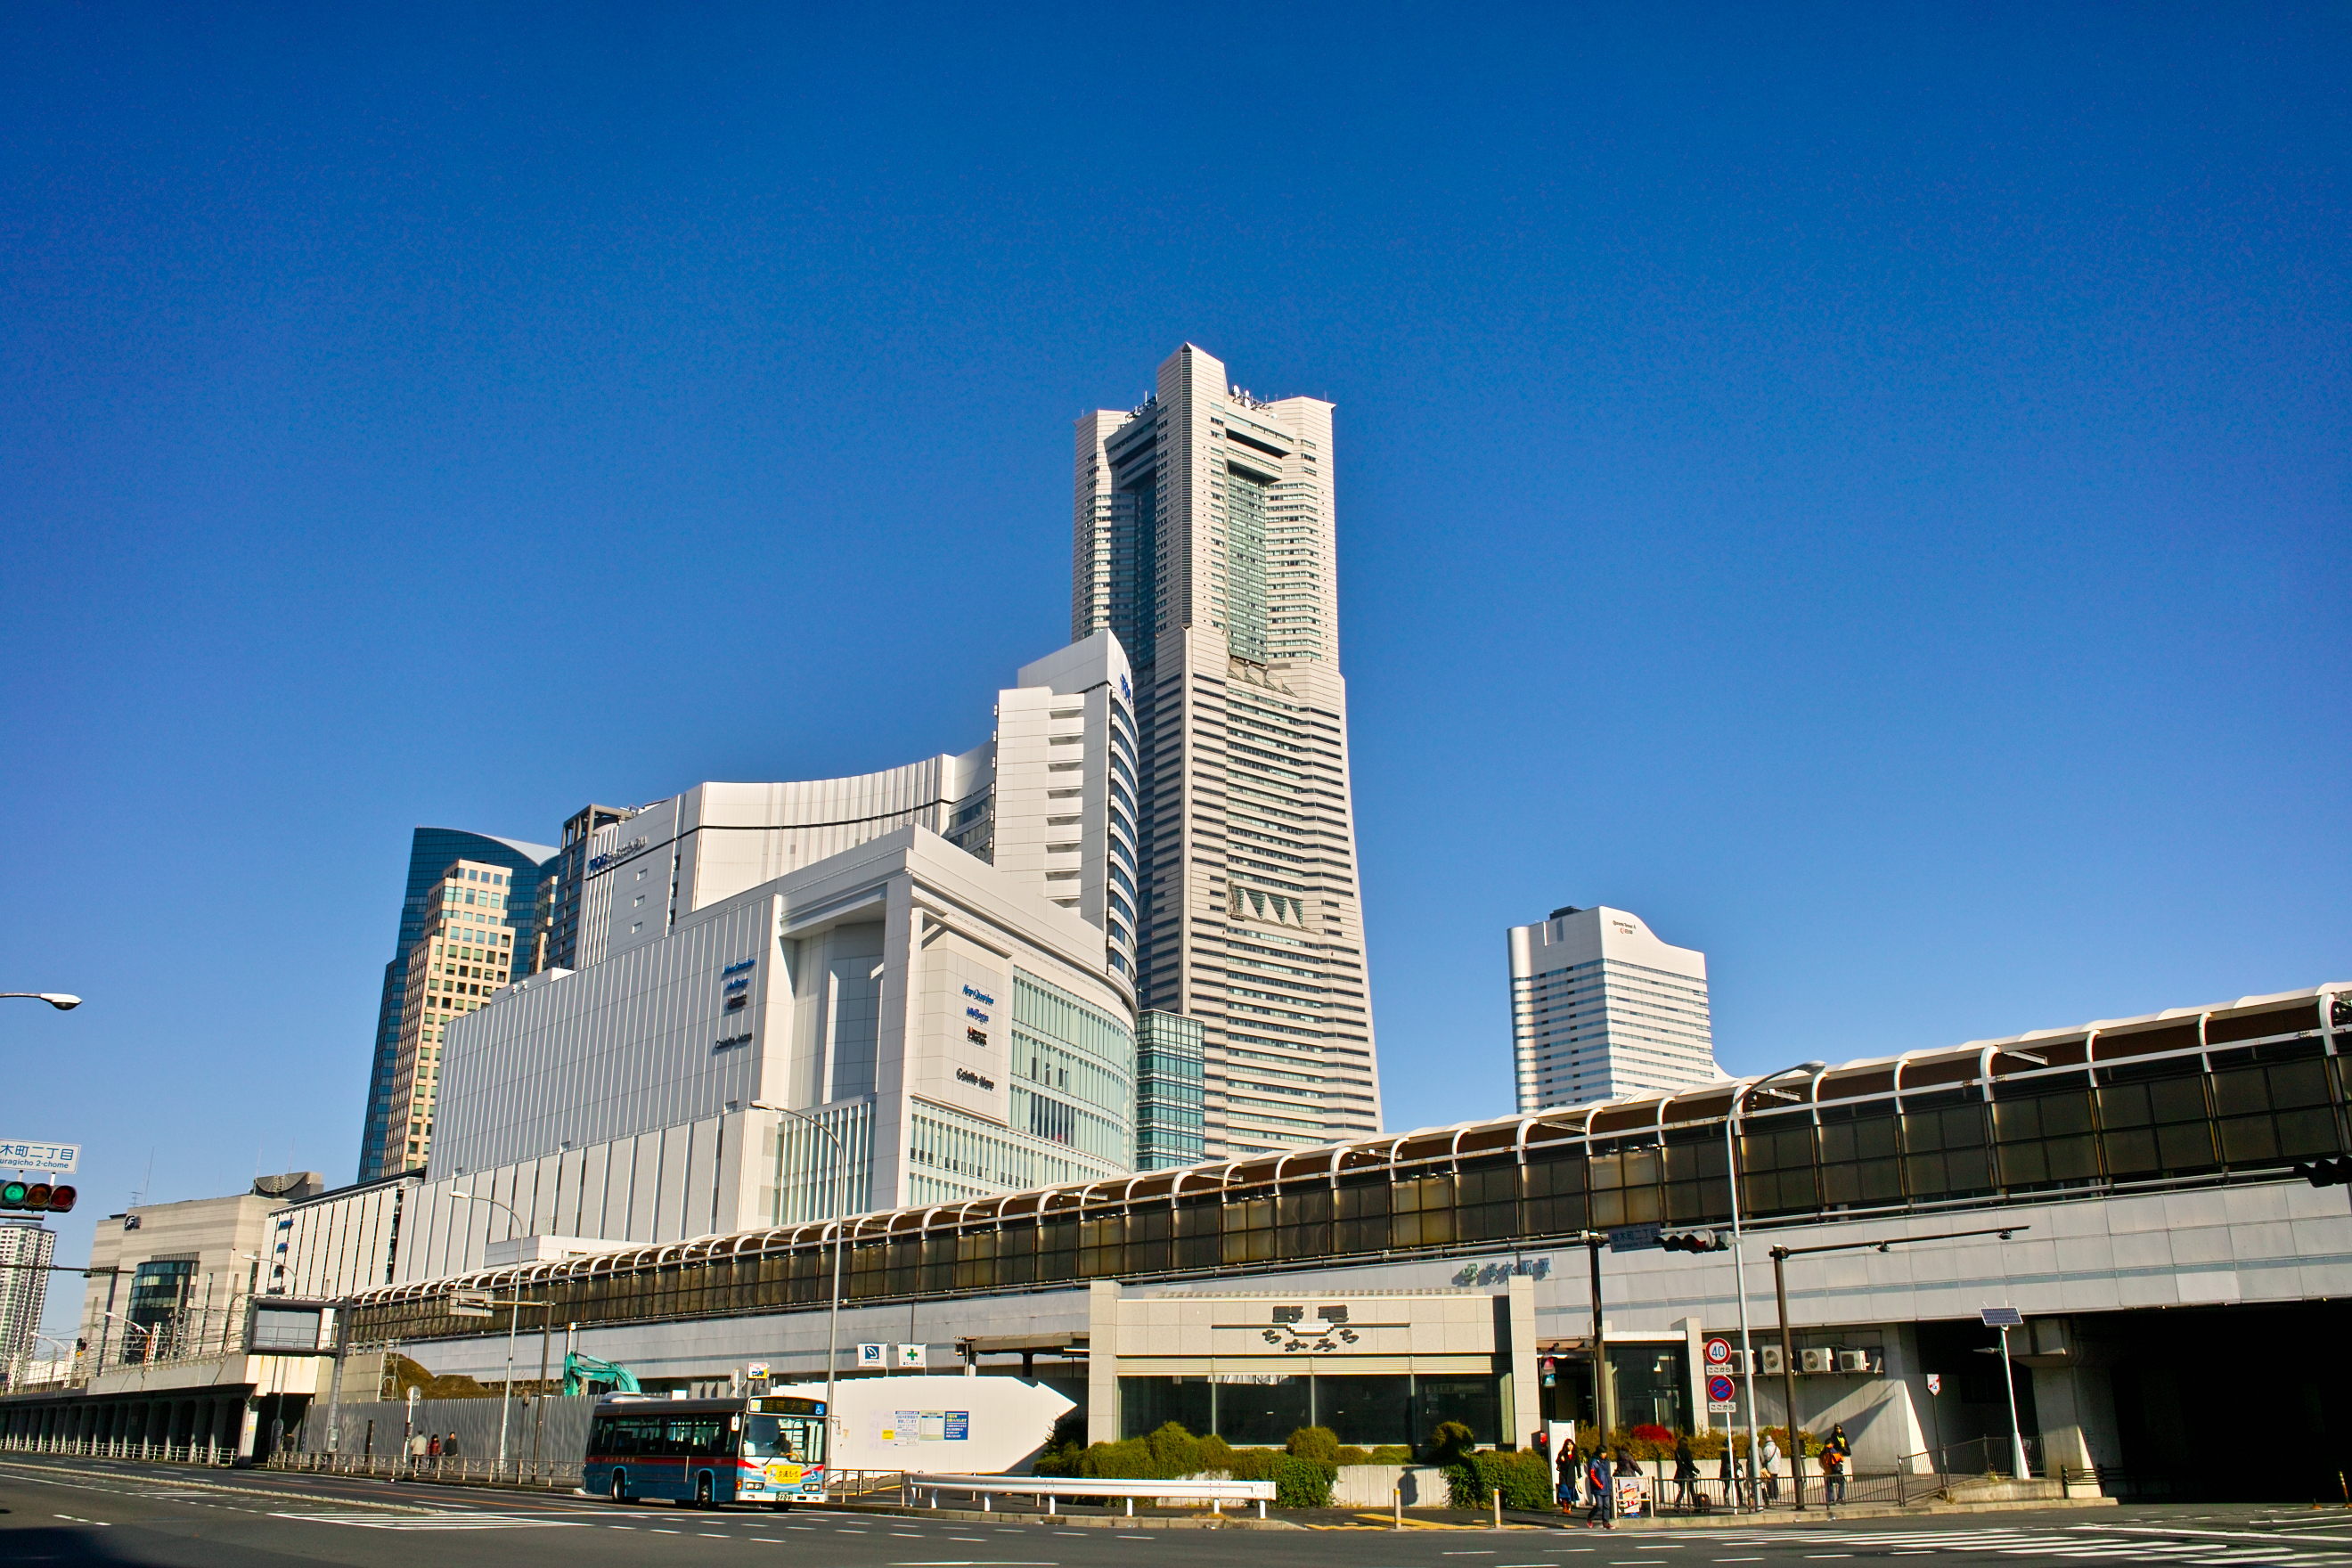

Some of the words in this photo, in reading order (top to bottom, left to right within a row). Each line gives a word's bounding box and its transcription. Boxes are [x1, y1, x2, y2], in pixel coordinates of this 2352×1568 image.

[589, 853, 608, 870] TOC
[0, 1144, 74, 1161] 木町二丁目
[36, 1160, 69, 1169] 2-chome
[1462, 1262, 1479, 1278] JR
[1485, 1257, 1551, 1278] 桜木町駅
[1271, 1304, 1350, 1323] 野毛
[1262, 1328, 1360, 1352] ちかみち
[1711, 1345, 1725, 1357] 40
